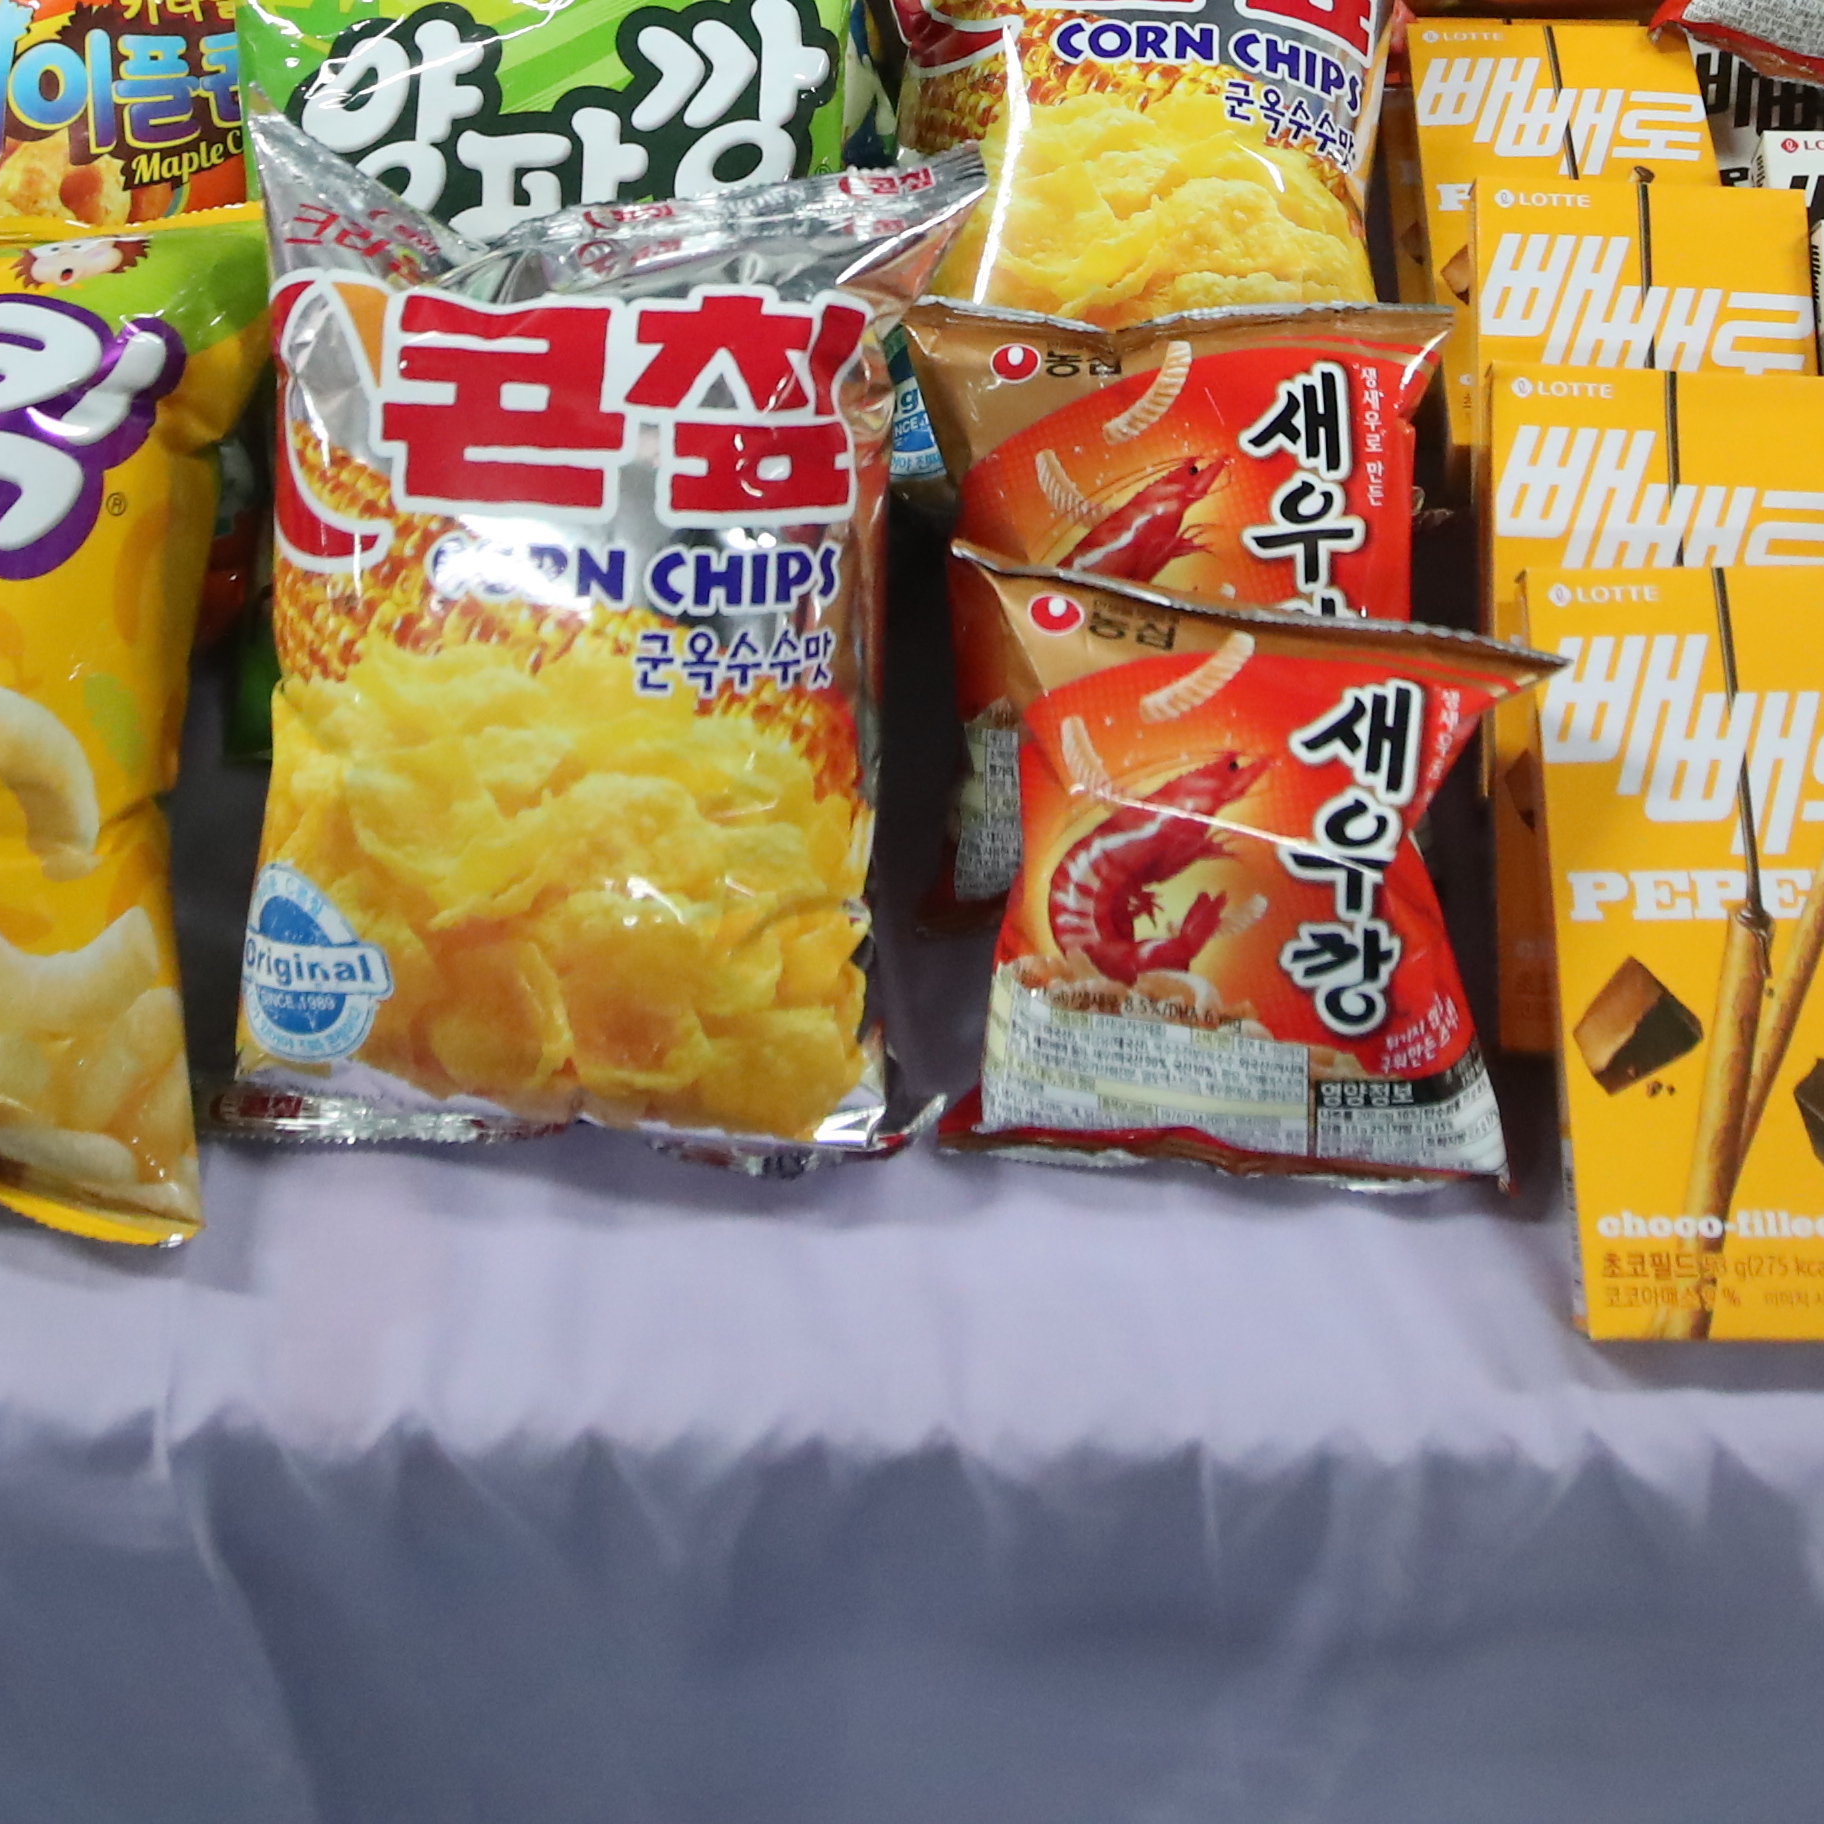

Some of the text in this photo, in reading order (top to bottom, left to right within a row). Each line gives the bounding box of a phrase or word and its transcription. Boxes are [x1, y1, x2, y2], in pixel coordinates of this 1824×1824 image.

[1054, 20, 1363, 118] CORN CHIPS
[1416, 57, 1707, 176] 빼빼로
[131, 143, 223, 186] Maple
[1519, 192, 1591, 208] LOTTE
[382, 294, 868, 511] 콘칩
[1537, 381, 1614, 400] LOTTE
[1240, 360, 1366, 616] 새우
[1365, 460, 1384, 507] 만든
[649, 544, 841, 609] CHIPS
[1577, 584, 1659, 603] LOTTE
[1087, 606, 1176, 651] 농심
[635, 631, 836, 694] 군옥수수맛
[1288, 679, 1428, 1037] 새우깡
[244, 935, 372, 987] Original
[1320, 1082, 1415, 1107] 영양정보
